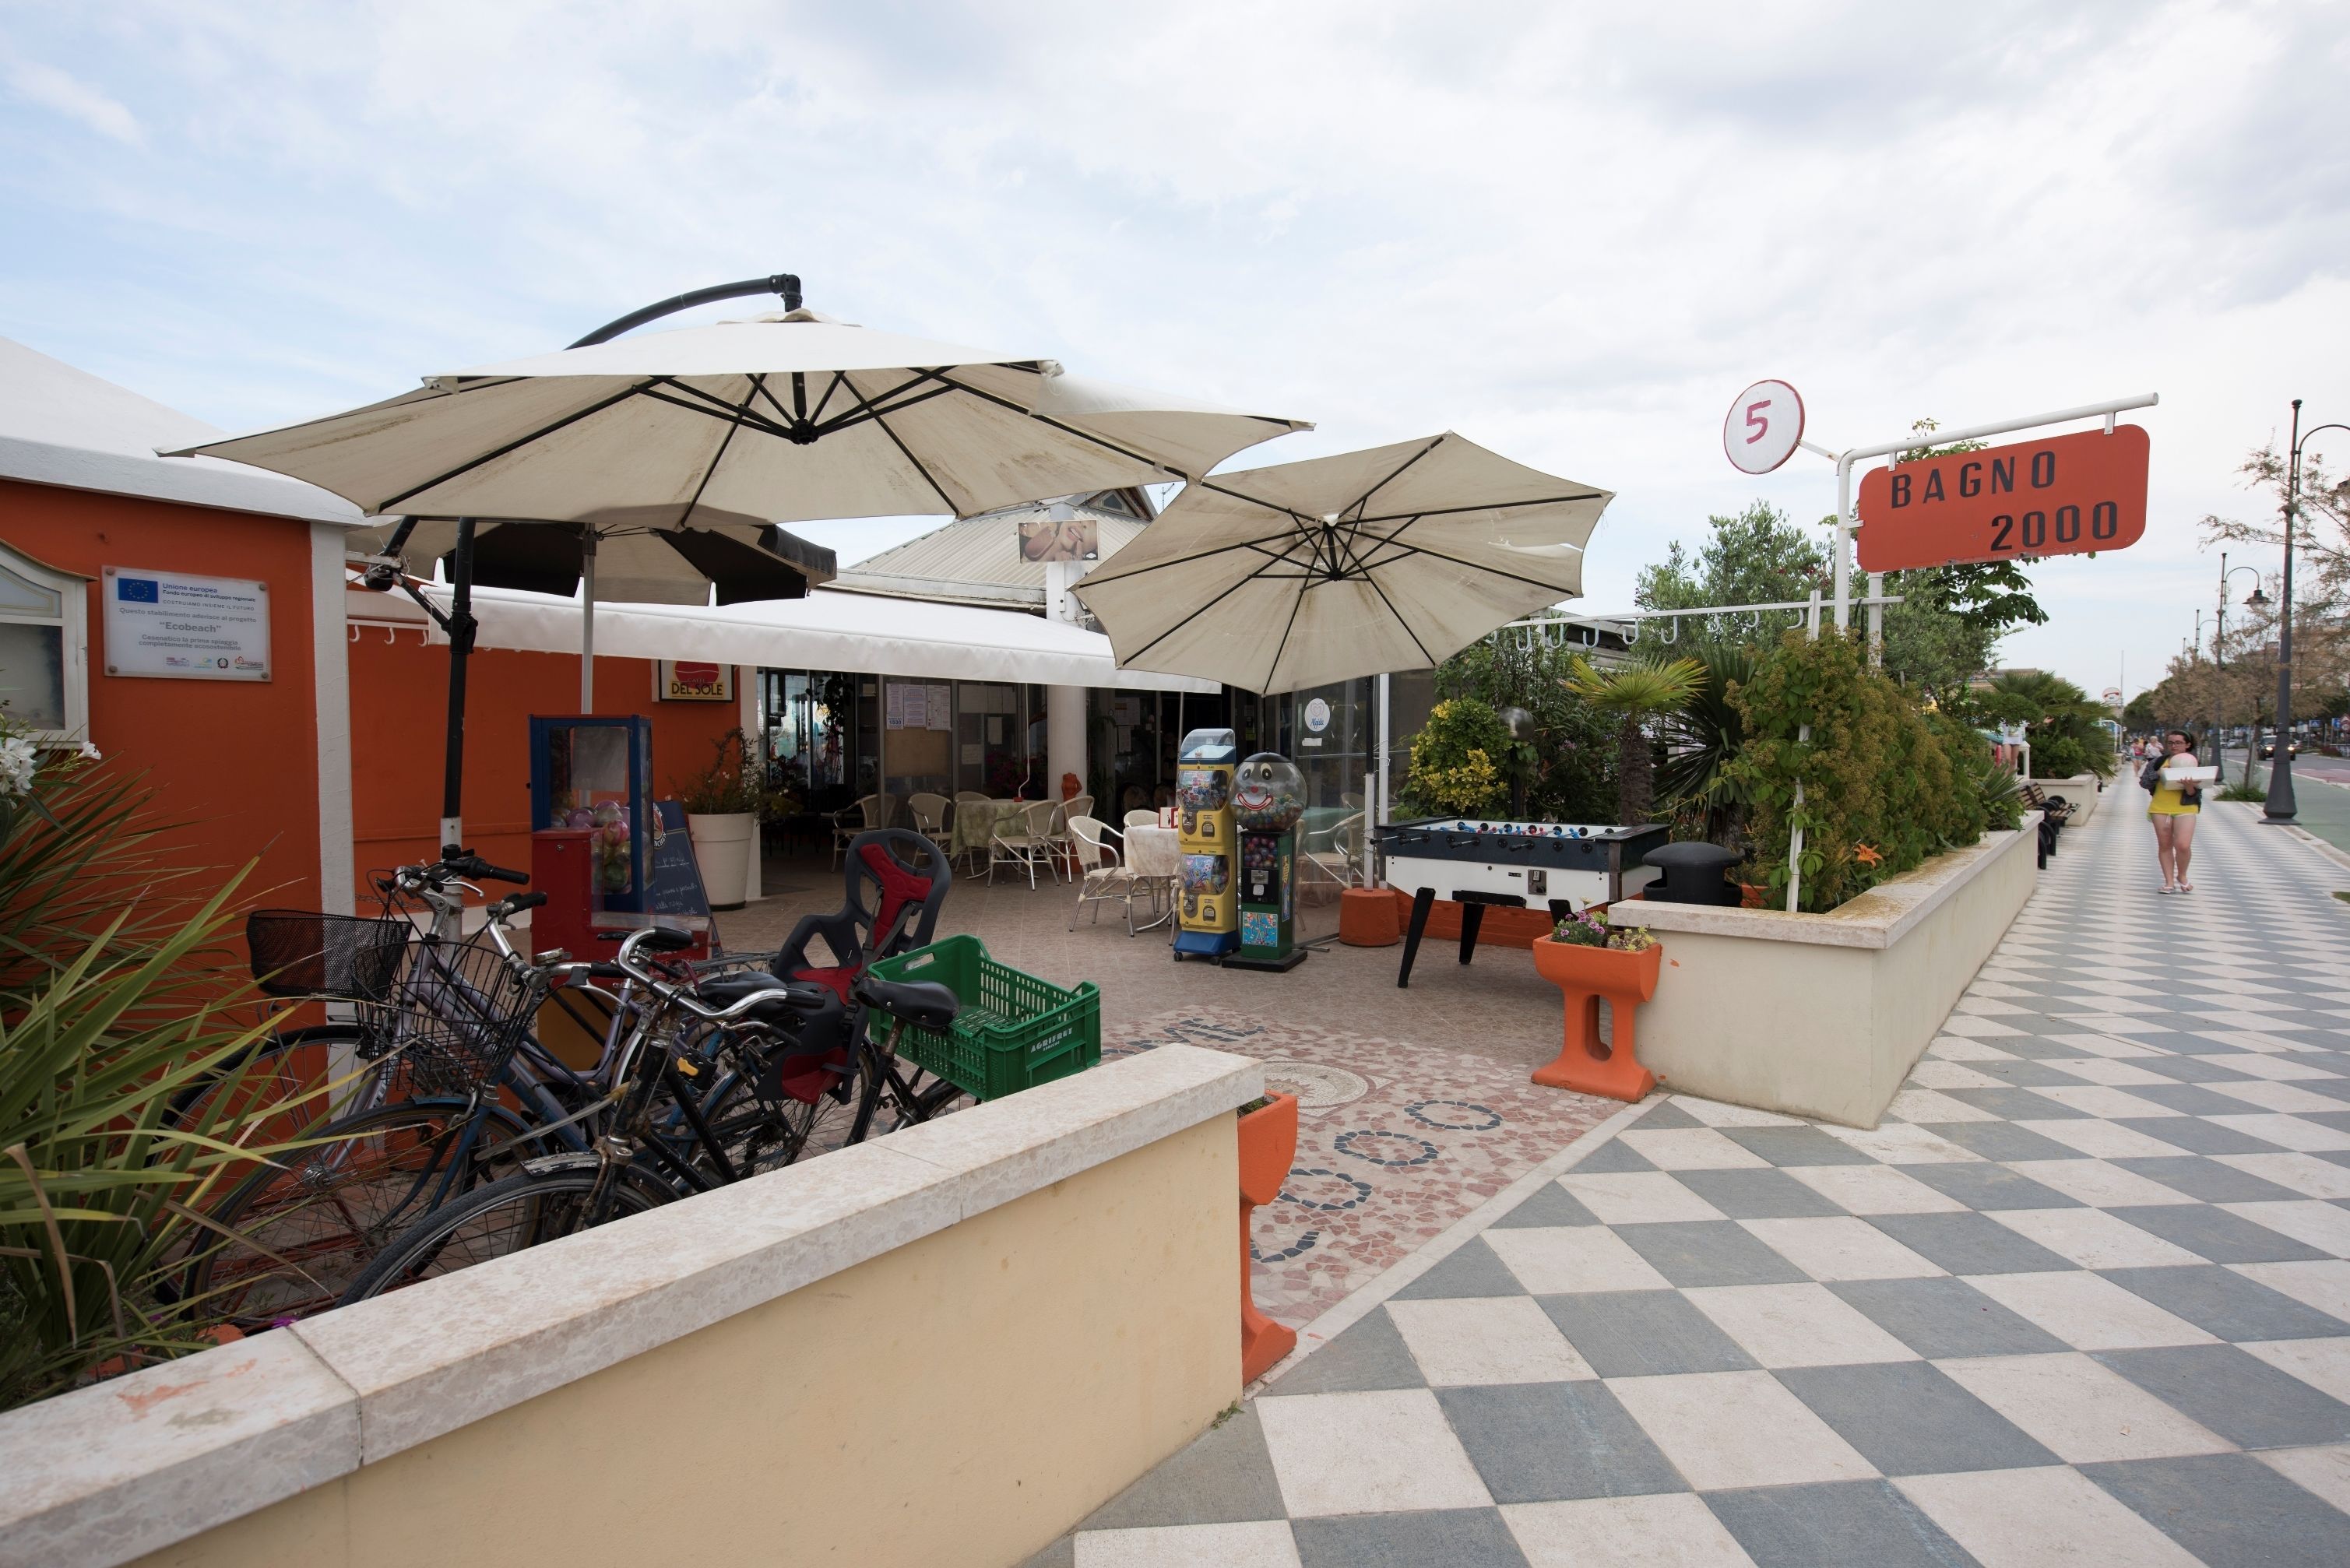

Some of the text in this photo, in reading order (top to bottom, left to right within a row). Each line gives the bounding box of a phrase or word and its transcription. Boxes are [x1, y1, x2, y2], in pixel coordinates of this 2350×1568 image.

[1746, 399, 1771, 445] 5
[1891, 450, 2056, 508] BAGNO
[1990, 501, 2118, 552] 2000
[147, 610, 191, 618] stabilimento
[142, 634, 181, 642] Cesenatico
[139, 640, 193, 649] completamente
[671, 683, 723, 695] DEL SOLE
